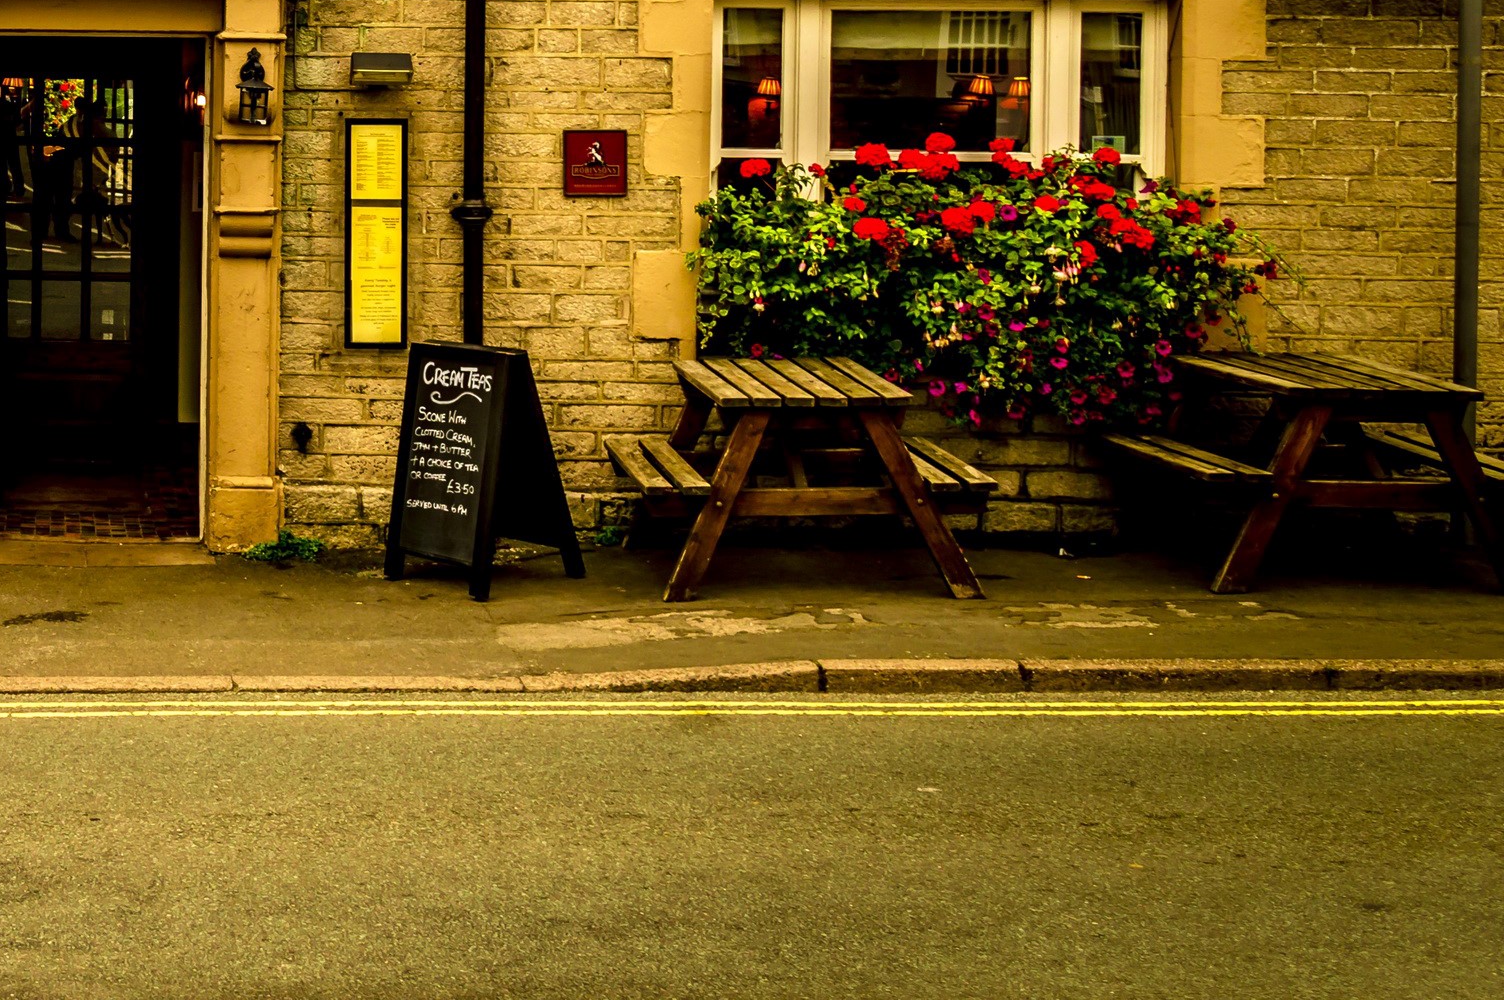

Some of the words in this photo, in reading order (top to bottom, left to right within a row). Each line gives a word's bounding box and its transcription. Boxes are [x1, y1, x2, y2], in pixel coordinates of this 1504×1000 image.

[423, 361, 464, 389] CREAM
[460, 366, 493, 392] TEAS
[418, 406, 446, 423] SCONE
[448, 410, 467, 425] WITH
[415, 426, 444, 439] CLOTTED
[412, 441, 431, 451] JAM
[439, 442, 472, 459] BUTTER
[419, 456, 425, 467] A
[427, 458, 452, 469] CHOICE
[454, 461, 464, 470] OF
[464, 463, 479, 472] TEA
[410, 471, 422, 480] OR
[423, 472, 447, 481] COFFEE
[406, 499, 432, 510] SERVED
